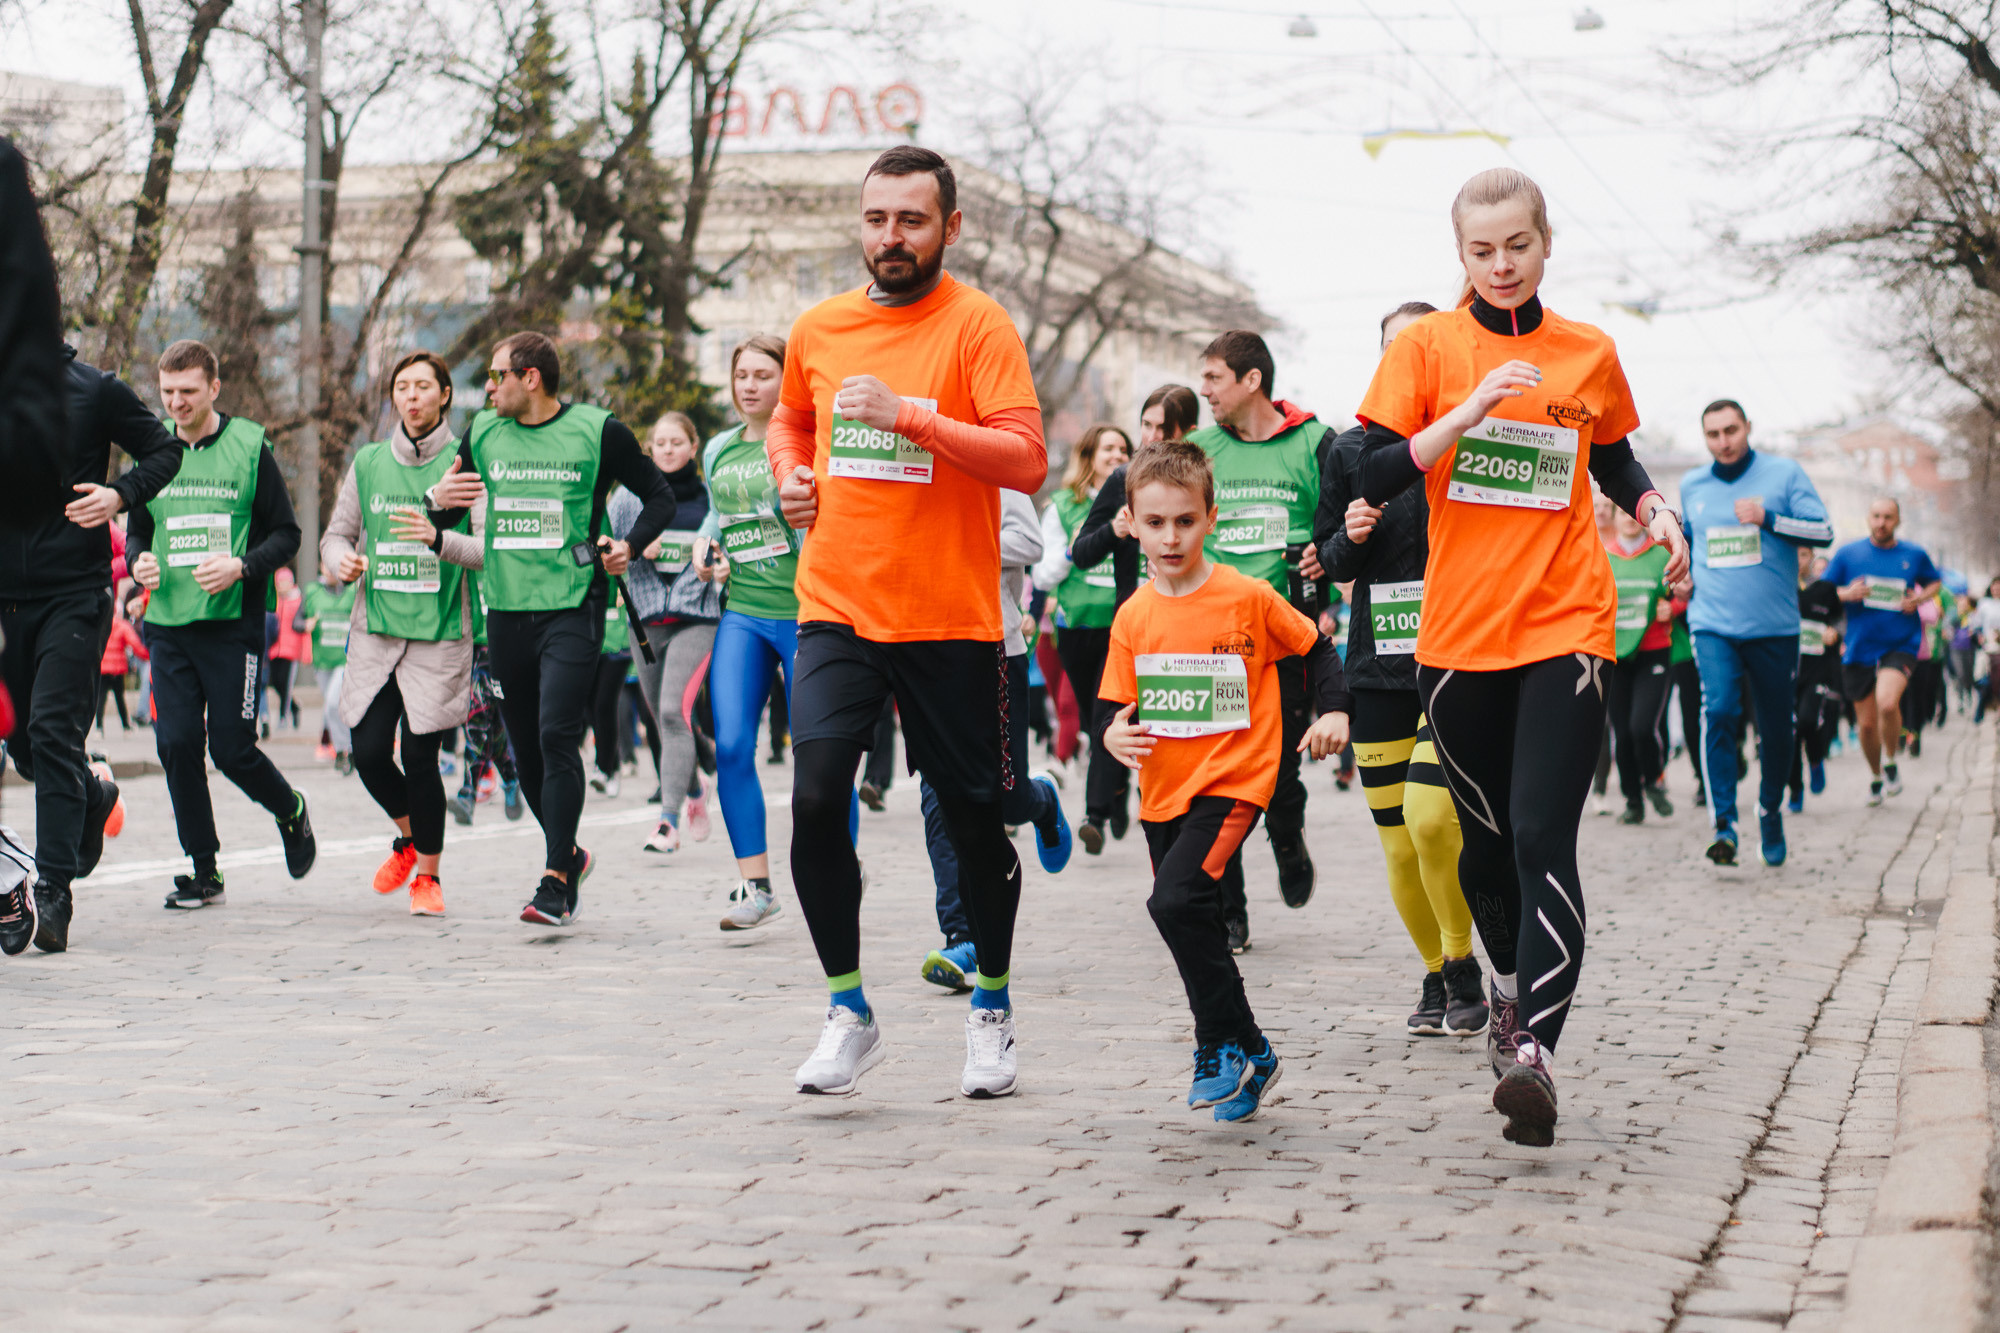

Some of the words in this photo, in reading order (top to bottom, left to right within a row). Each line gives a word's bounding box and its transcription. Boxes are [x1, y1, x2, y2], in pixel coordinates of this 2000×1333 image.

[1550, 406, 1591, 422] ACADEMY
[834, 427, 895, 451] 22068
[1501, 433, 1555, 447] NUTRITION
[1502, 426, 1556, 440] HERBALIFE
[900, 444, 911, 453] 1,6
[508, 460, 582, 471] HERBALIFE
[1457, 451, 1534, 482] 22069
[1541, 454, 1570, 465] FAMILY
[1539, 461, 1569, 475] RUN
[506, 469, 582, 482] NUTRITION
[1537, 476, 1549, 486] 1,6
[1552, 478, 1567, 488] KM
[172, 478, 239, 488] HERBALIFE
[1222, 479, 1298, 491] HERBALIFE
[170, 486, 239, 500] NUTRITION
[1220, 487, 1298, 502] NUTRITION
[497, 518, 540, 533] 21023
[726, 528, 762, 548] 20334
[1219, 525, 1263, 543] 20627
[169, 533, 208, 550] 20223
[660, 548, 680, 560] 770
[377, 561, 415, 576] 20151
[1375, 611, 1421, 632] 2100
[1173, 658, 1227, 666] HERBALIFE
[1173, 665, 1227, 673] NUTRITION
[1142, 688, 1211, 712] 22067
[1216, 688, 1244, 699] RUN
[1216, 703, 1228, 712] 1,6
[1230, 703, 1245, 711] KM
